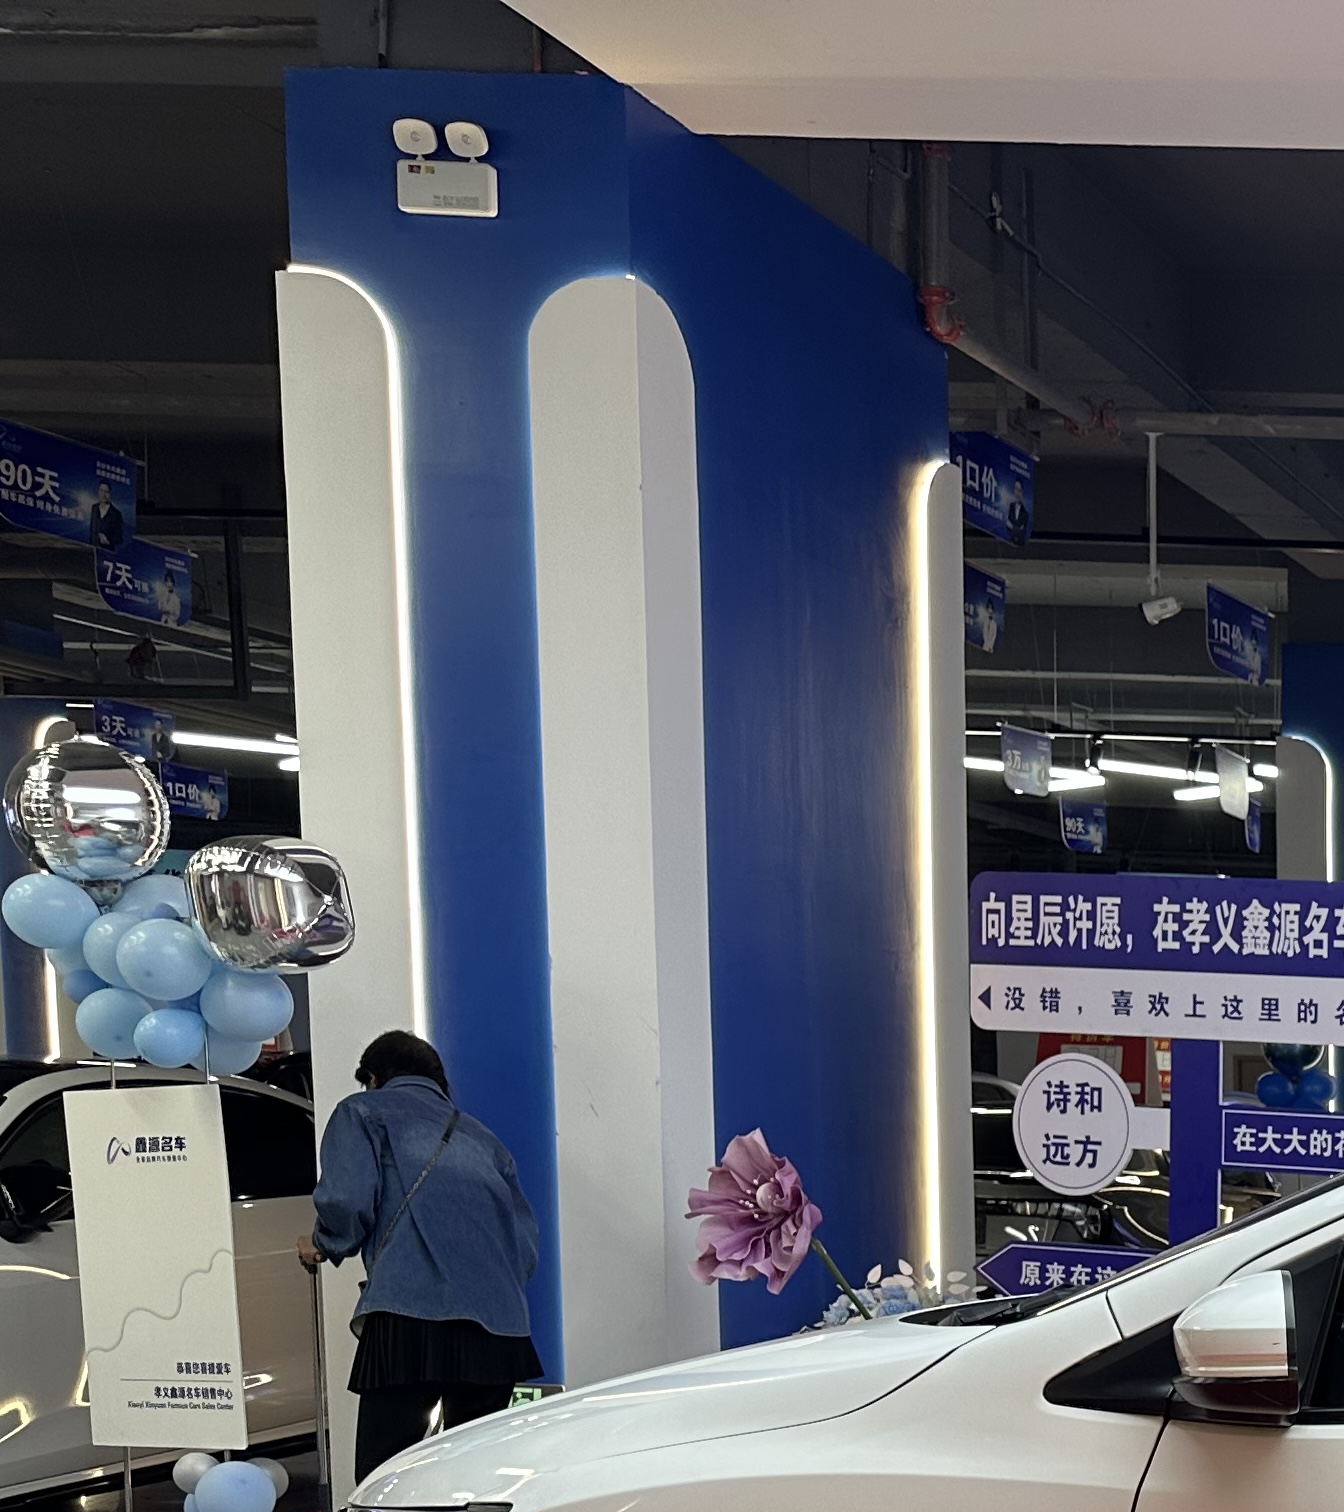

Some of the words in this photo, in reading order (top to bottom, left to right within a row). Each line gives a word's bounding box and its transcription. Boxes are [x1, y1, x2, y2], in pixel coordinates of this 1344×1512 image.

[0, 458, 61, 502] 90天
[166, 781, 200, 801] 1口价
[1042, 1080, 1104, 1116] 诗和
[135, 1135, 187, 1153] 鑫源名车
[1042, 1132, 1103, 1170] 远方
